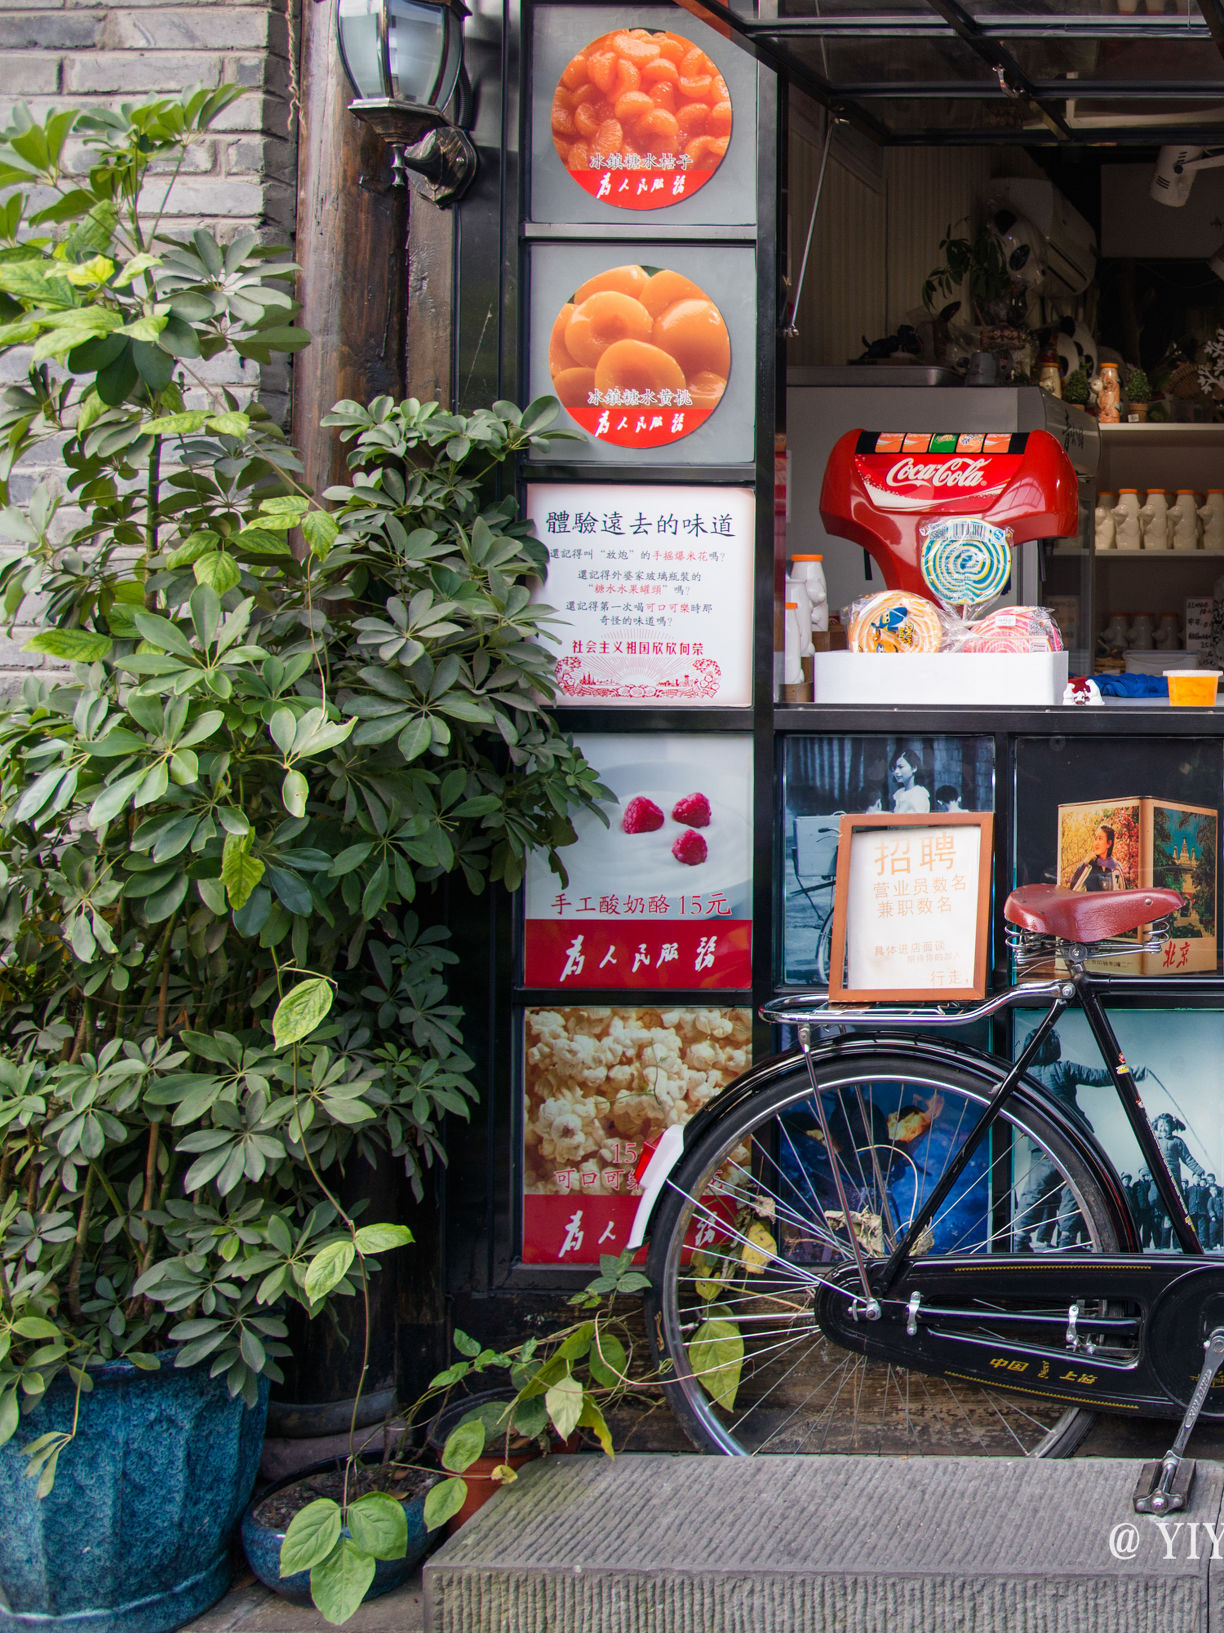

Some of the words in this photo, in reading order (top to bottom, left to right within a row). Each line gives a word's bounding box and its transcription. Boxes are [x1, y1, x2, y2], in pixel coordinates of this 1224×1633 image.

[885, 457, 993, 488] Coca-Cola
[545, 509, 737, 538] 體驗遠去的味道
[571, 639, 705, 656] 社会主义祖国欣欣向荣
[873, 831, 957, 877] 招聘
[873, 874, 967, 899] 营业员数名
[877, 896, 953, 919] 兼职数名
[1162, 940, 1191, 969] 北京
[989, 1358, 1030, 1372] 中国
